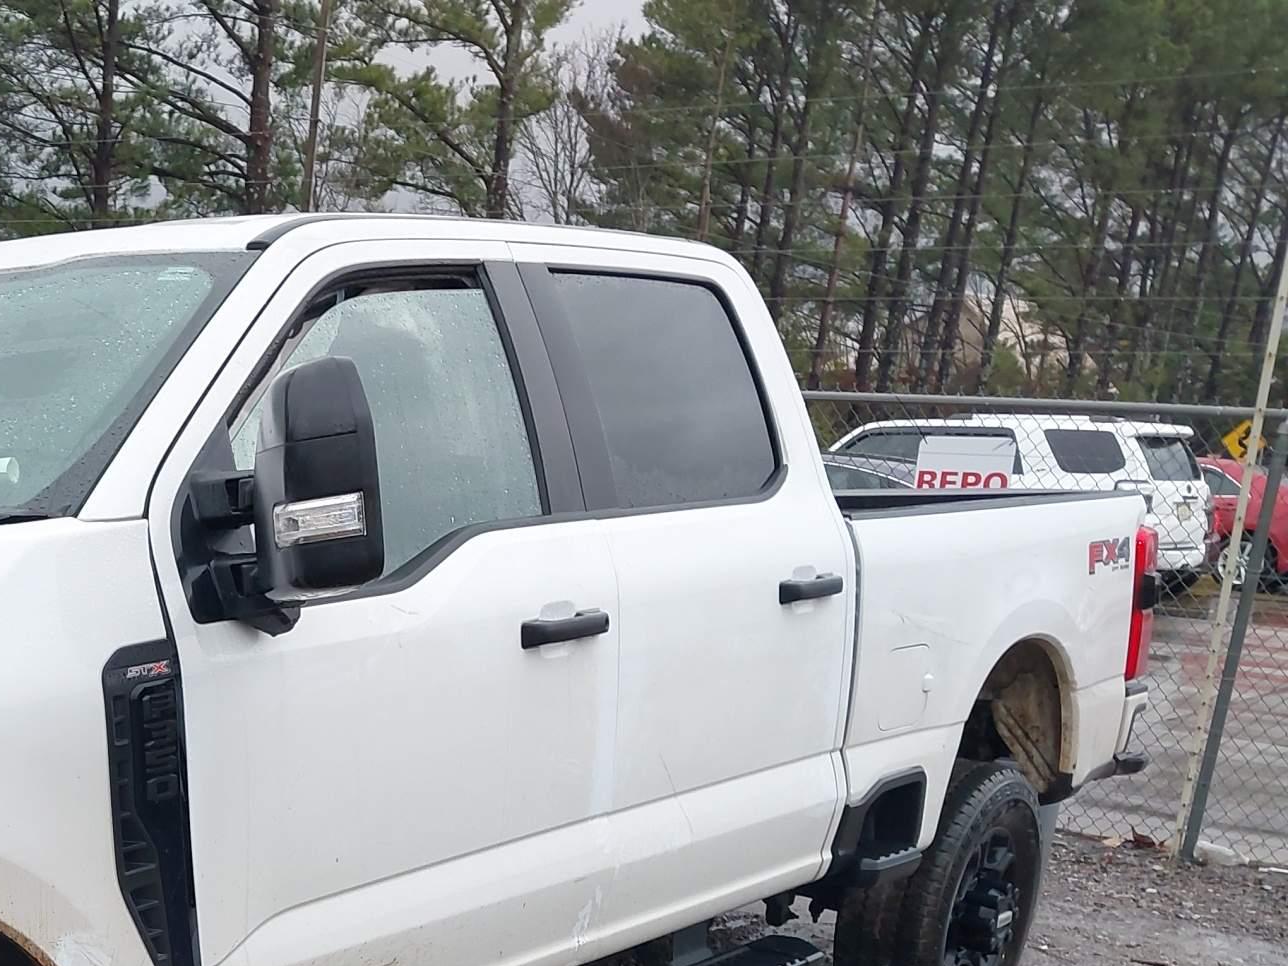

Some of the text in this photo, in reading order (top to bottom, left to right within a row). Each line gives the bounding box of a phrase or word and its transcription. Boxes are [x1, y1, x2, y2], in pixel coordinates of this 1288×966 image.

[916, 470, 1009, 489] REPO
[1088, 536, 1130, 575] FX4
[126, 660, 171, 679] STX
